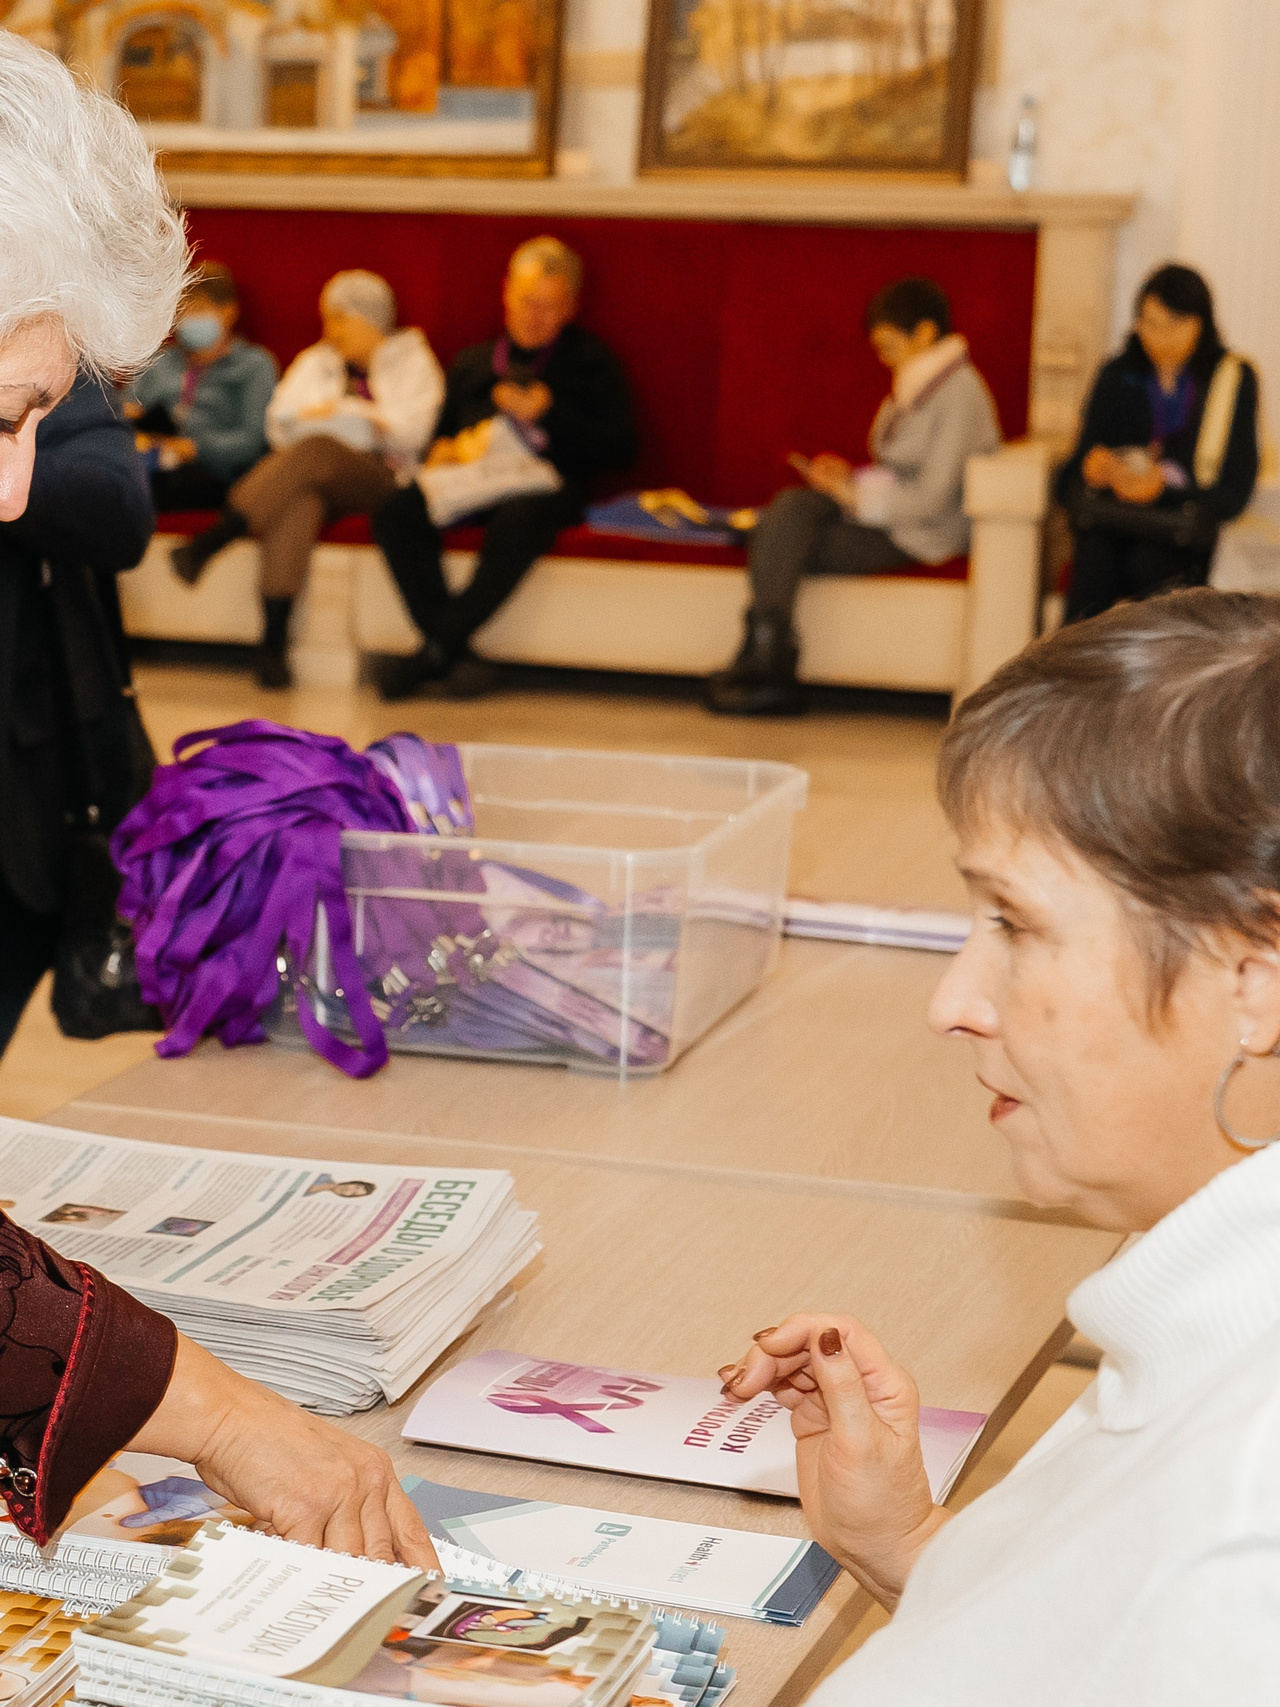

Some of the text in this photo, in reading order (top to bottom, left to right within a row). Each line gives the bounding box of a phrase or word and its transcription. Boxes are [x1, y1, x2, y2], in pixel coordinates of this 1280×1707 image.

[391, 1179, 477, 1248] БЕСЕДЫ
[380, 1246, 424, 1256] О
[308, 1255, 413, 1302] ЗДОРОВЬЕ
[683, 1400, 744, 1448] ПРОГРАМ
[667, 1536, 723, 1584] Health Direct
[307, 1573, 365, 1603] РАК
[241, 1600, 339, 1657] ЖЕЛУДКА
